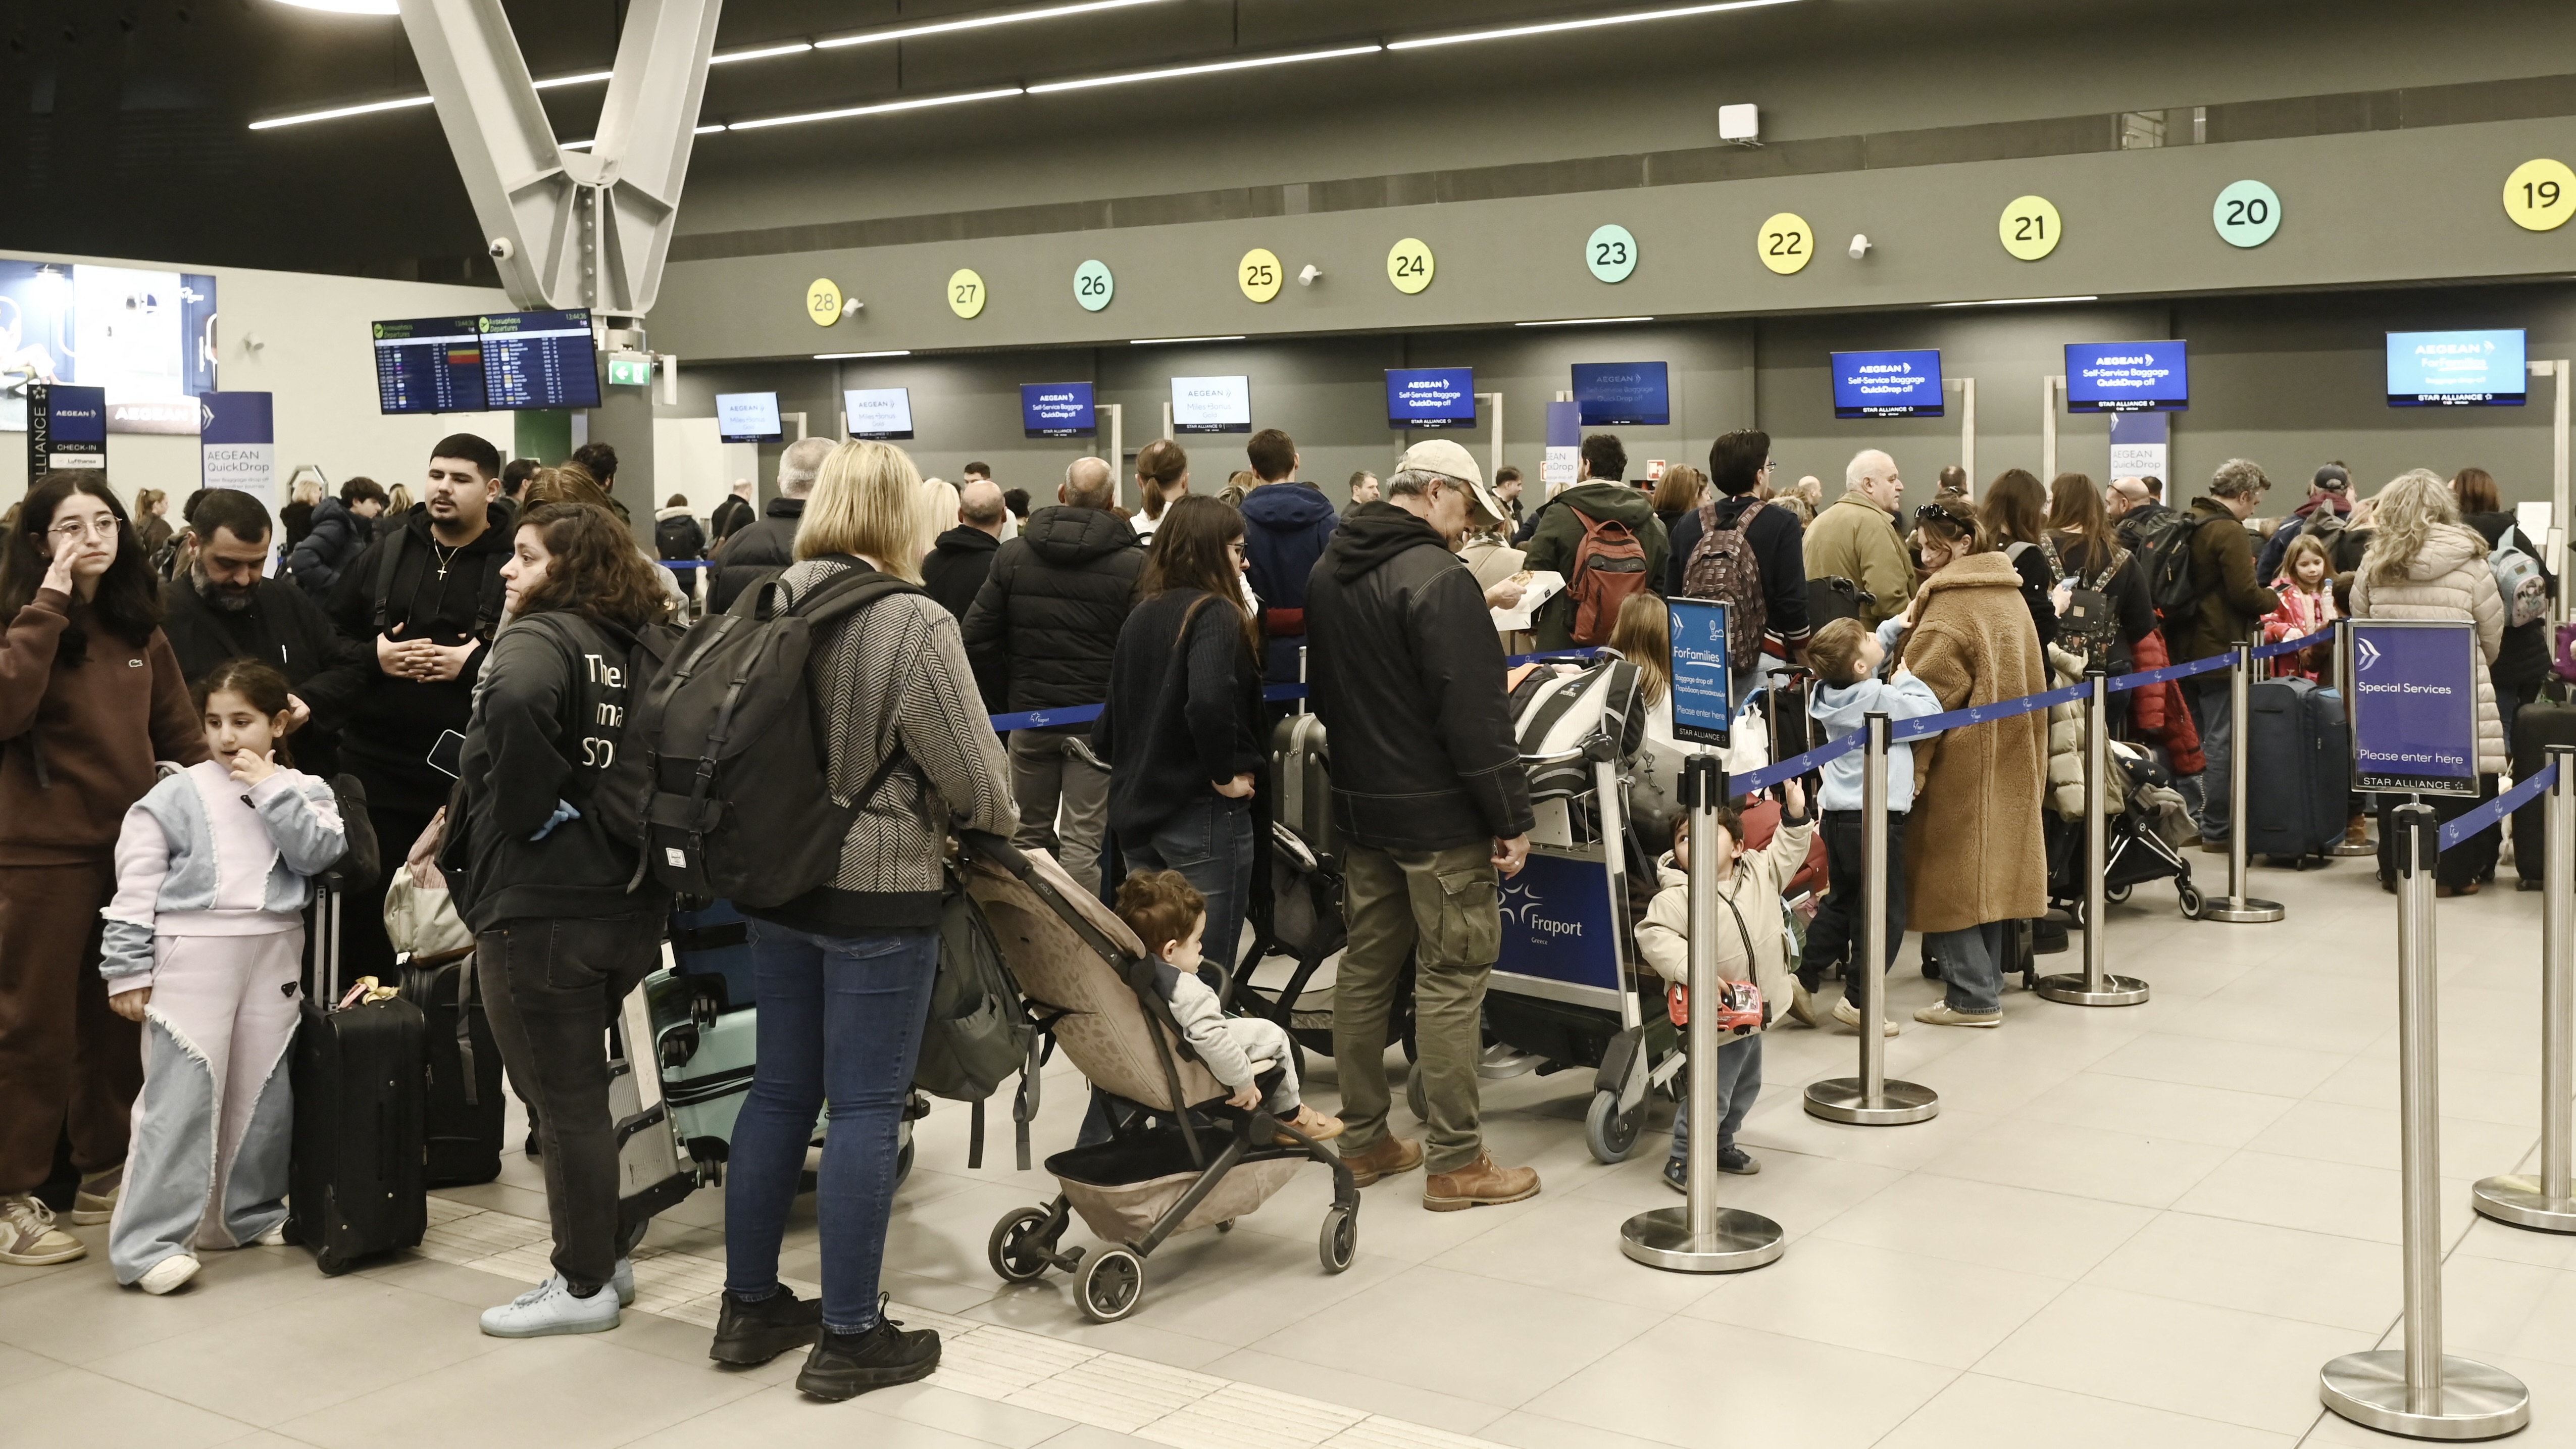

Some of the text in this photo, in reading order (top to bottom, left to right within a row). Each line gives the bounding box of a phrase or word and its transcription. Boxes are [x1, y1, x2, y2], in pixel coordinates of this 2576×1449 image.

[2523, 181, 2560, 209] 19
[2227, 199, 2267, 226] 20
[2015, 216, 2044, 241] 21
[1770, 232, 1801, 255] 22
[1596, 242, 1627, 265] 23
[1396, 256, 1425, 277] 24
[1247, 265, 1273, 286] 25
[1081, 275, 1105, 295] 26
[956, 284, 976, 304] 27
[814, 293, 834, 311] 28
[2415, 344, 2480, 354] AEGEAN
[2096, 357, 2143, 365] AEGEAN
[1859, 365, 1901, 373] AEGEAN
[2083, 368, 2169, 378] Self-Service Baggage
[1890, 376, 1925, 385] Baggage
[2097, 378, 2155, 388] QuickDrop off
[1433, 391, 1460, 399] Baggage
[1860, 386, 1902, 394] QuickDrop
[115, 407, 188, 421] AEGEAN
[34, 407, 47, 480] LLIANCE
[208, 451, 259, 460] AEGEAN
[2113, 450, 2152, 458] AEGEAN
[208, 462, 269, 473] QuickDrop
[2113, 460, 2161, 470] QuickDrop
[1674, 646, 1720, 663] ForFamilies
[584, 654, 621, 687] The
[1675, 673, 1695, 684] Baggage
[1695, 677, 1706, 686] drop
[2358, 681, 2452, 695] Special Services
[1677, 705, 1725, 721] Please enter here
[1679, 728, 1720, 741] STAR ALLIANCE
[2360, 749, 2463, 764] Please enter here
[2363, 777, 2451, 789] STAR ALLIANCE
[1532, 913, 1582, 937] Fraport
[1531, 937, 1548, 945] Greece
